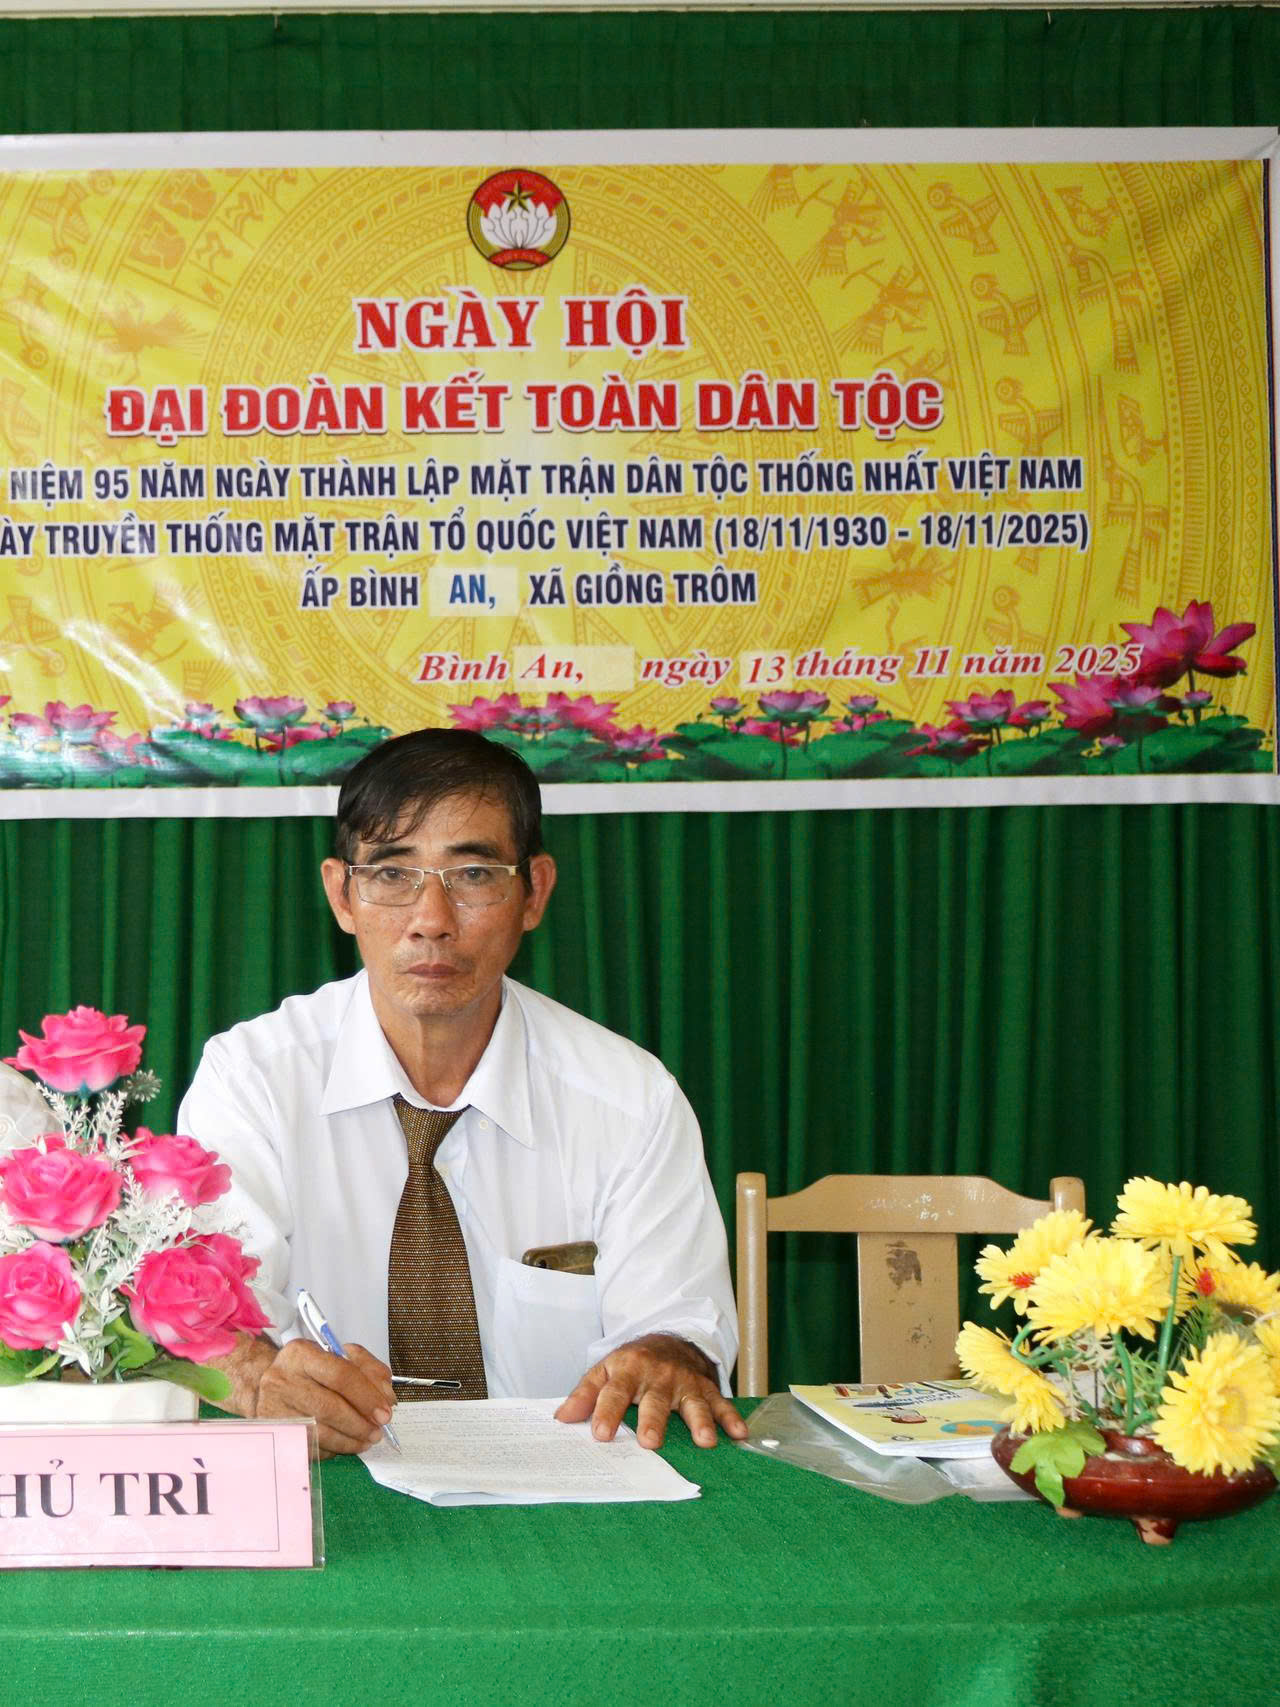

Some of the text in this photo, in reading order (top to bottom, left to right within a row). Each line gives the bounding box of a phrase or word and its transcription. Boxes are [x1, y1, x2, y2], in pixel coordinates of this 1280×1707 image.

[359, 289, 684, 354] NGÀY HỘI
[108, 371, 940, 442] ĐẠI ĐOÀN KẾT TOÀN DÂN TỘC
[11, 463, 83, 506] NIỆM
[94, 469, 129, 500] 95
[141, 461, 204, 499] NĂM
[216, 462, 291, 498] NGÀY
[300, 459, 396, 498] THÀNH
[407, 458, 458, 503] LẬP
[471, 456, 532, 503] MẶT
[540, 456, 615, 502] TRẬN
[626, 455, 683, 494] DÂN
[692, 455, 748, 501] TỘC
[757, 451, 854, 493] THỐNG
[864, 450, 939, 492] NHẤT
[947, 451, 1011, 497] VIỆT
[1019, 458, 1082, 490] NAM
[44, 512, 155, 555] TRUYỀN
[166, 511, 263, 554] THỐNG
[274, 515, 336, 560] MẶT
[344, 513, 419, 559] TRẬN
[429, 506, 466, 551] TỔ
[476, 508, 556, 554] QUỐC
[566, 511, 629, 556] VIỆT
[639, 518, 702, 549] NAM
[714, 516, 887, 555] (18/11/1930
[897, 530, 910, 538] -
[920, 513, 1089, 551] 18/11/2025)
[301, 562, 756, 609] ẤP BÌNH AN, XÃ GIỒNG TRÔM
[420, 644, 1141, 690] Bình An, ngày 13 tháng 11 năm 2025
[99, 1457, 213, 1516] TRÌ
